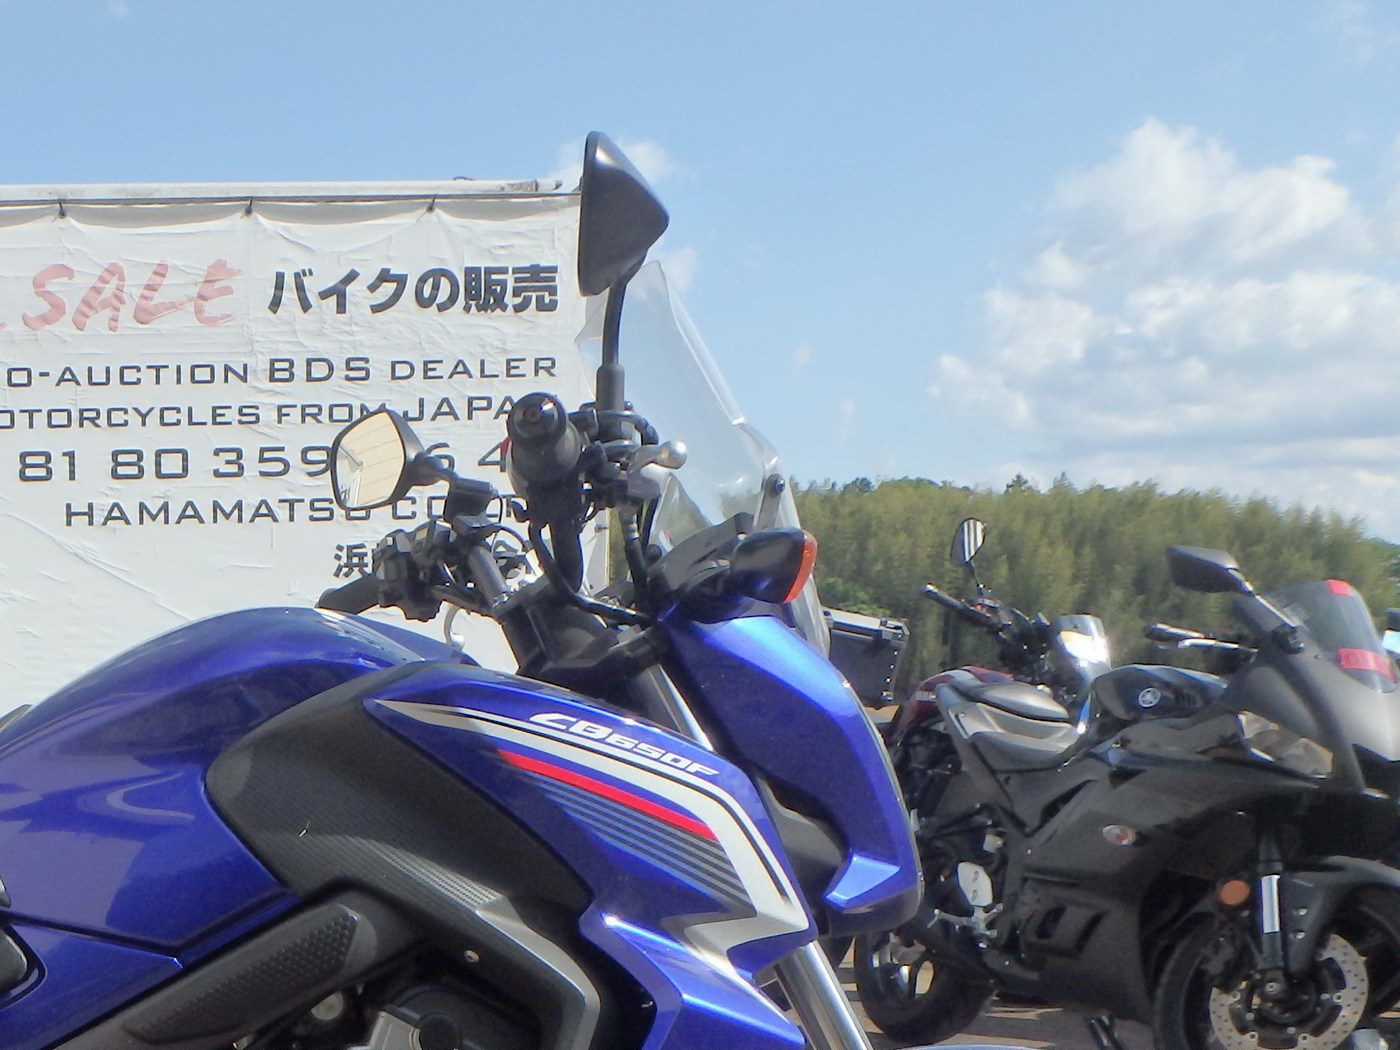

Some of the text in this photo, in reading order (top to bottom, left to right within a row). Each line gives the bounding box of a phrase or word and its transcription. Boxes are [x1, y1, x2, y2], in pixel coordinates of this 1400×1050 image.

[21, 258, 243, 332] SALE
[268, 263, 558, 317] バイクの販売
[268, 356, 372, 383] BDS
[390, 356, 557, 381] DEALER
[402, 395, 518, 422] JAPA
[19, 451, 77, 484] 81
[111, 449, 189, 481] 80
[528, 711, 720, 776] CB650F
